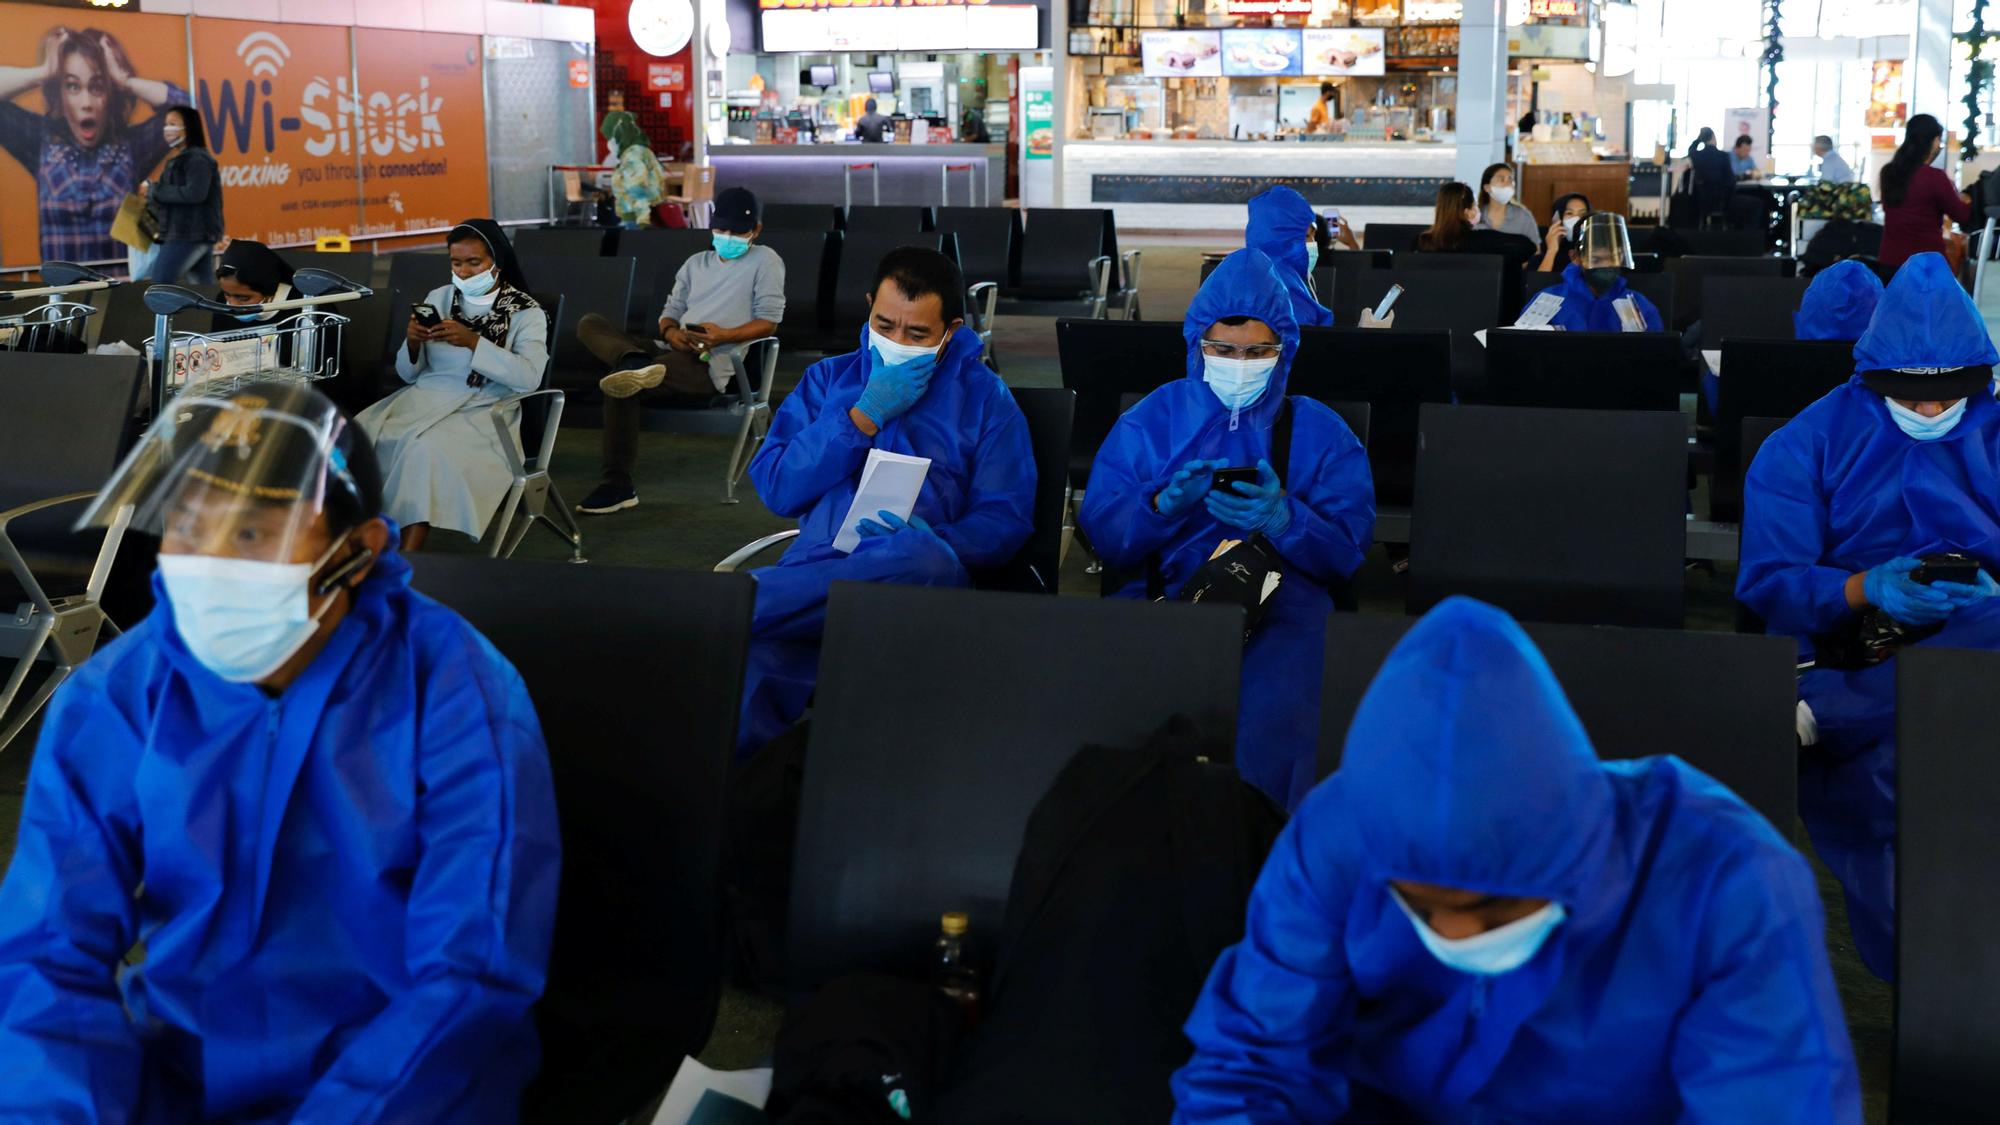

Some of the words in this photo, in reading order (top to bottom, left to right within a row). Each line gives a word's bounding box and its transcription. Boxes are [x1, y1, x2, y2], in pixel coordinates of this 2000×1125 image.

[298, 166, 322, 186] you
[325, 162, 376, 182] through
[380, 158, 448, 178] connection!
